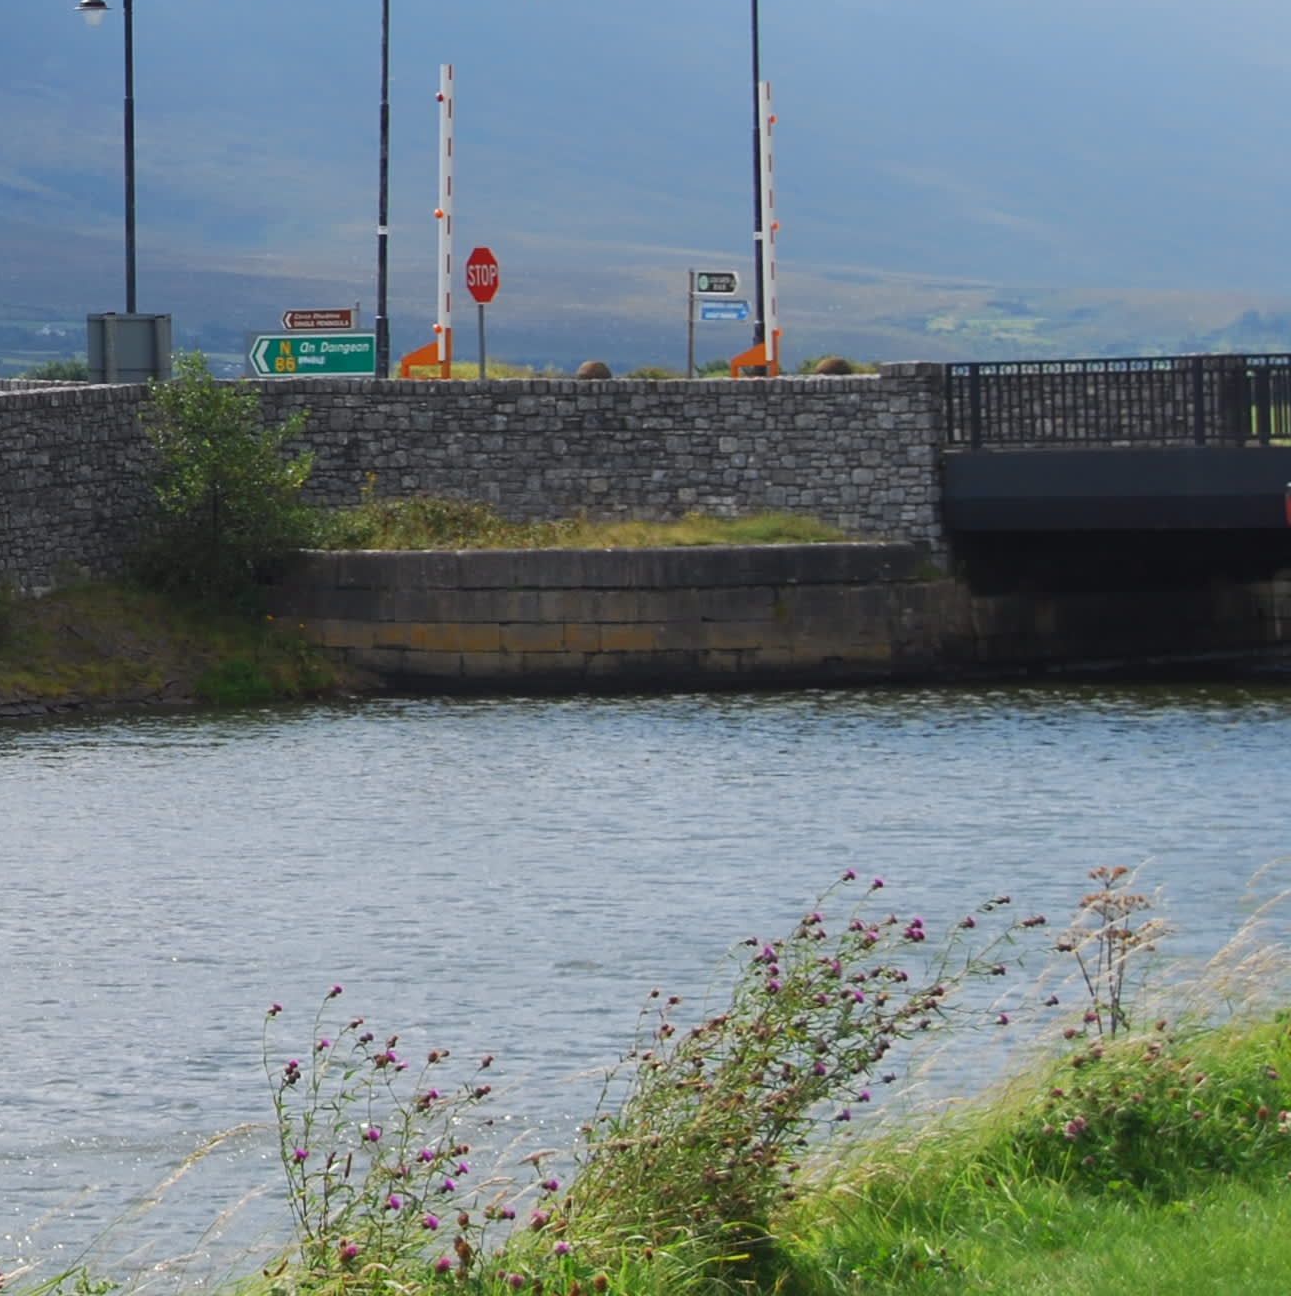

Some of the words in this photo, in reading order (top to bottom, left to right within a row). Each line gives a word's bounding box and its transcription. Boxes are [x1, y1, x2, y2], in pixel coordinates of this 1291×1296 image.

[468, 264, 496, 286] STOP
[280, 341, 291, 354] N
[300, 341, 316, 352] An
[320, 341, 369, 354] Daingean
[275, 356, 296, 372] 86
